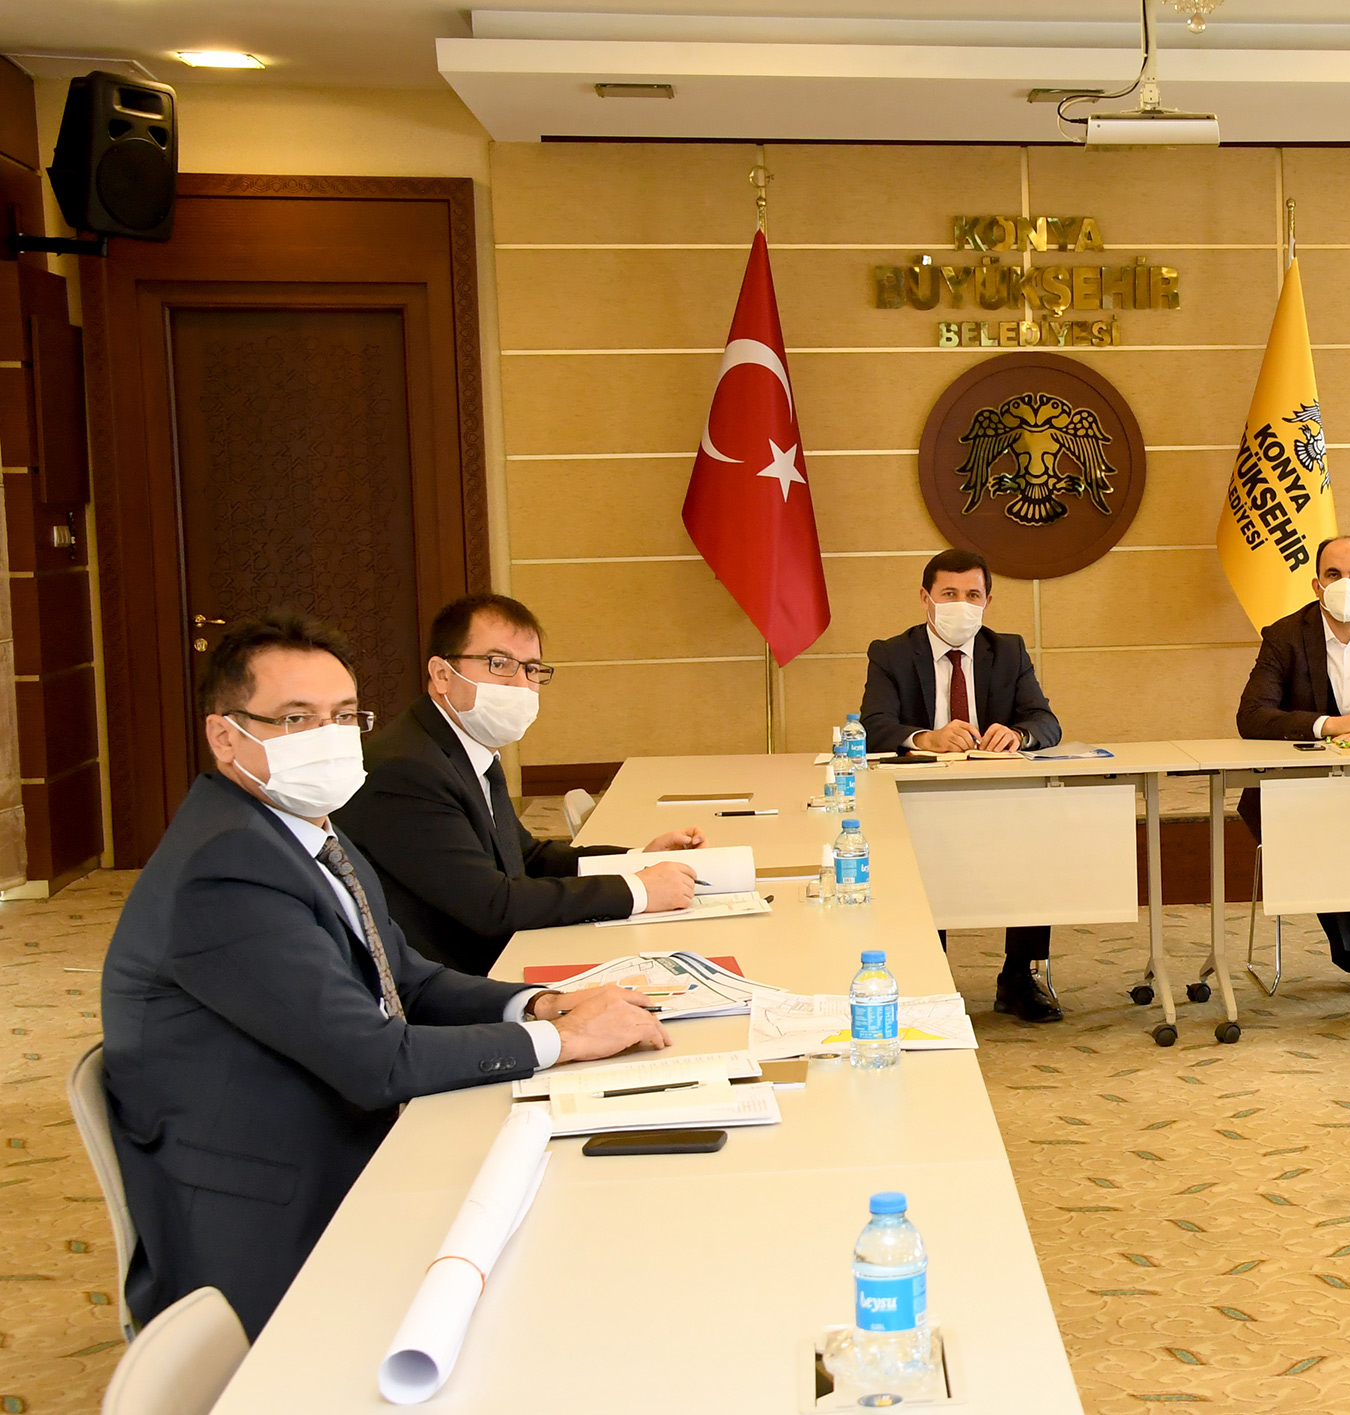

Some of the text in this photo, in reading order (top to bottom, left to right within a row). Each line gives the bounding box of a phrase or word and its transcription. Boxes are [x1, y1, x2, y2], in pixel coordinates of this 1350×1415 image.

[954, 216, 1104, 252] KONYA
[874, 255, 1181, 318] BÜYÜKŞEHİR
[939, 314, 1121, 347] BELEDİYESİ
[1254, 423, 1311, 514] KONYA
[1236, 421, 1310, 573] YÜKŞEHİR
[860, 1291, 898, 1312] beysu
